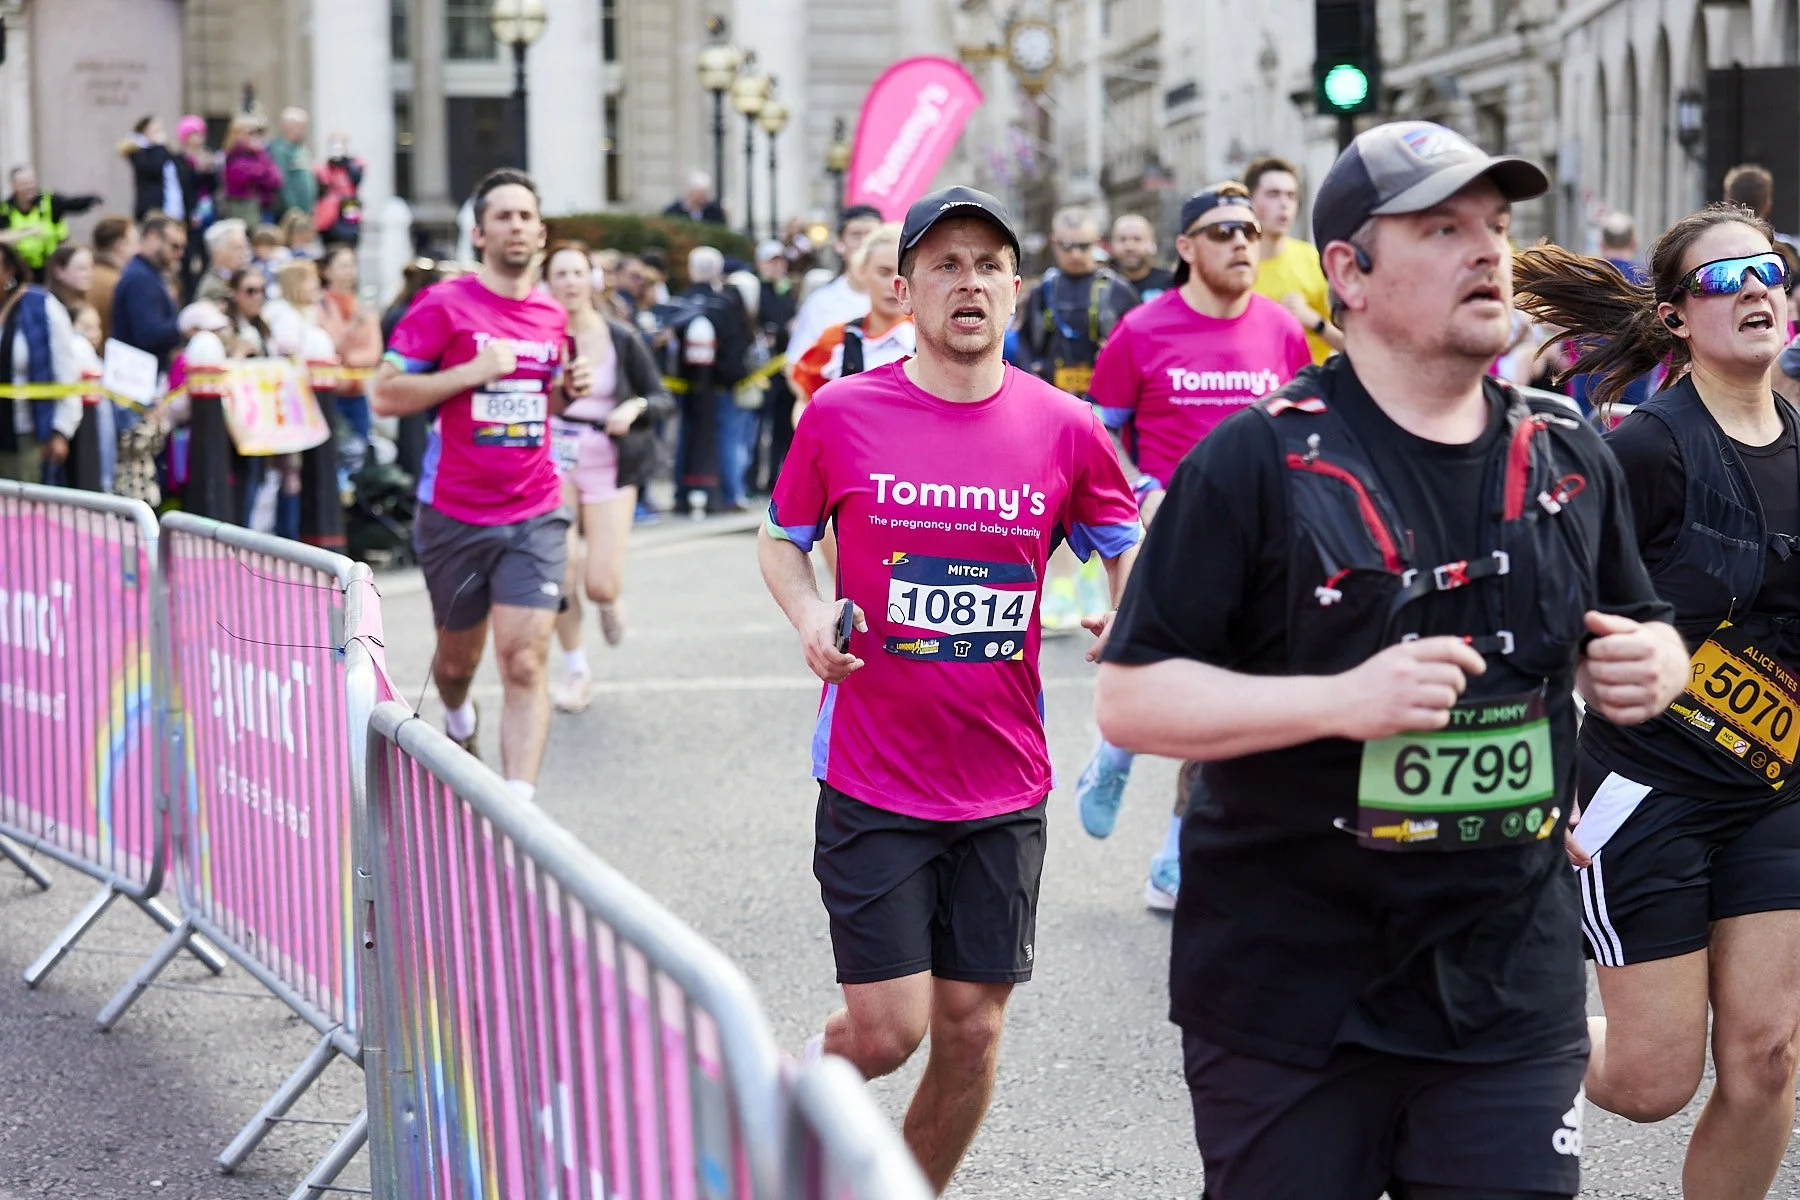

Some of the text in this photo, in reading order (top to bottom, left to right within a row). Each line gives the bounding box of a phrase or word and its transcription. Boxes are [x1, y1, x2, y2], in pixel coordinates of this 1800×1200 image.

[1166, 367, 1280, 396] Tommy's
[487, 398, 539, 418] 8951
[869, 473, 1046, 521] Tommy's
[868, 515, 1041, 540] The pregnancy and baby charity
[947, 564, 989, 578] MITCH
[901, 587, 1025, 627] 10814
[1743, 645, 1798, 693] ALICE YATES
[1475, 703, 1529, 724] JIMMY
[1704, 661, 1794, 743] 5070
[1723, 732, 1734, 742] NO
[1394, 740, 1532, 796] 6799
